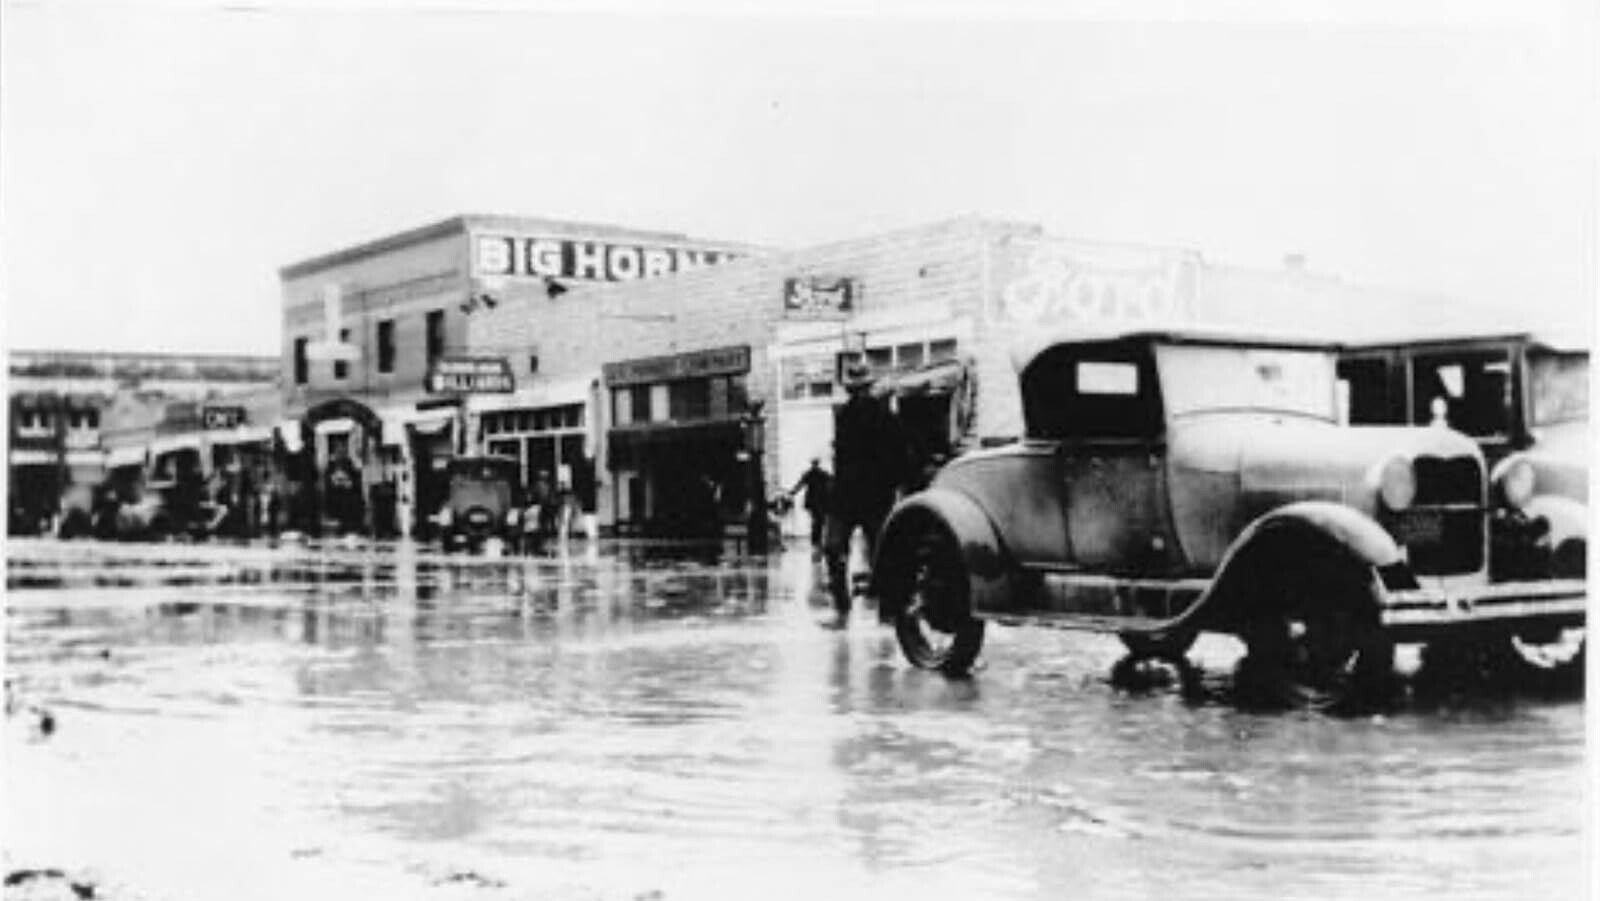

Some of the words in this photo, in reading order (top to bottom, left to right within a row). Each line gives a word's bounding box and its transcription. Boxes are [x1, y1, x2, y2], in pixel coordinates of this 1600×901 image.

[478, 236, 562, 277] BIG
[787, 279, 847, 308] Ford
[1005, 255, 1180, 323] Ford
